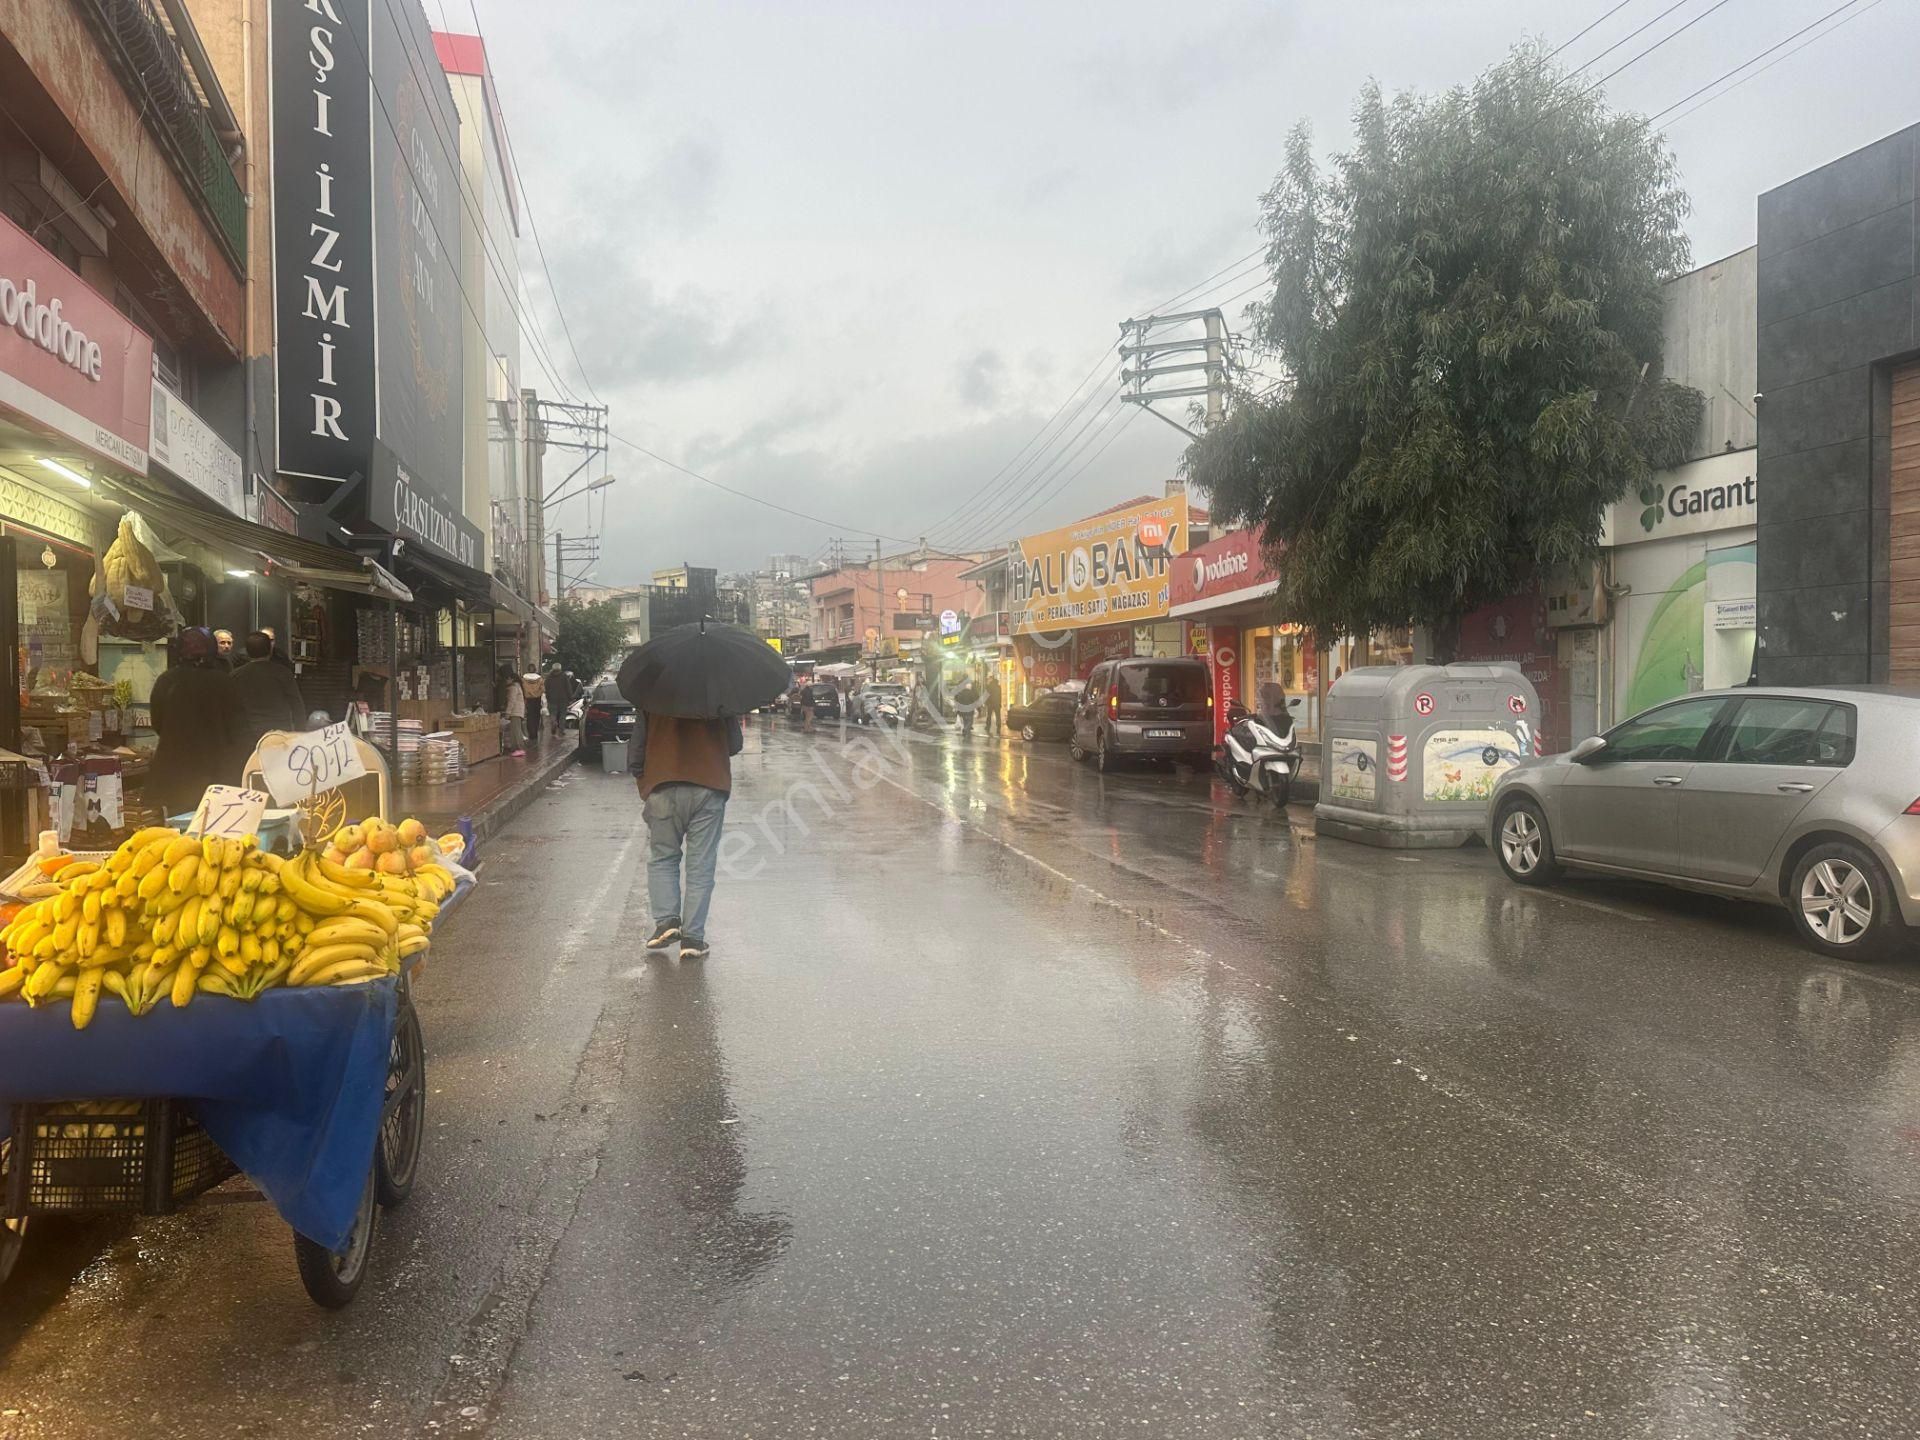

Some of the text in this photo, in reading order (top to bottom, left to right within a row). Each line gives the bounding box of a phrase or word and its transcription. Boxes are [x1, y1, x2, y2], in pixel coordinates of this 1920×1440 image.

[302, 163, 350, 441] İZMİR
[394, 479, 429, 545] ÇARŞI
[430, 495, 458, 558] İZMİR
[1013, 523, 1179, 602] HALI BANK
[1205, 550, 1248, 582] vodafone
[1047, 602, 1084, 620] PERAKENDE
[1087, 598, 1108, 617] SATIŞ
[1112, 591, 1150, 611] MAĞAZASI
